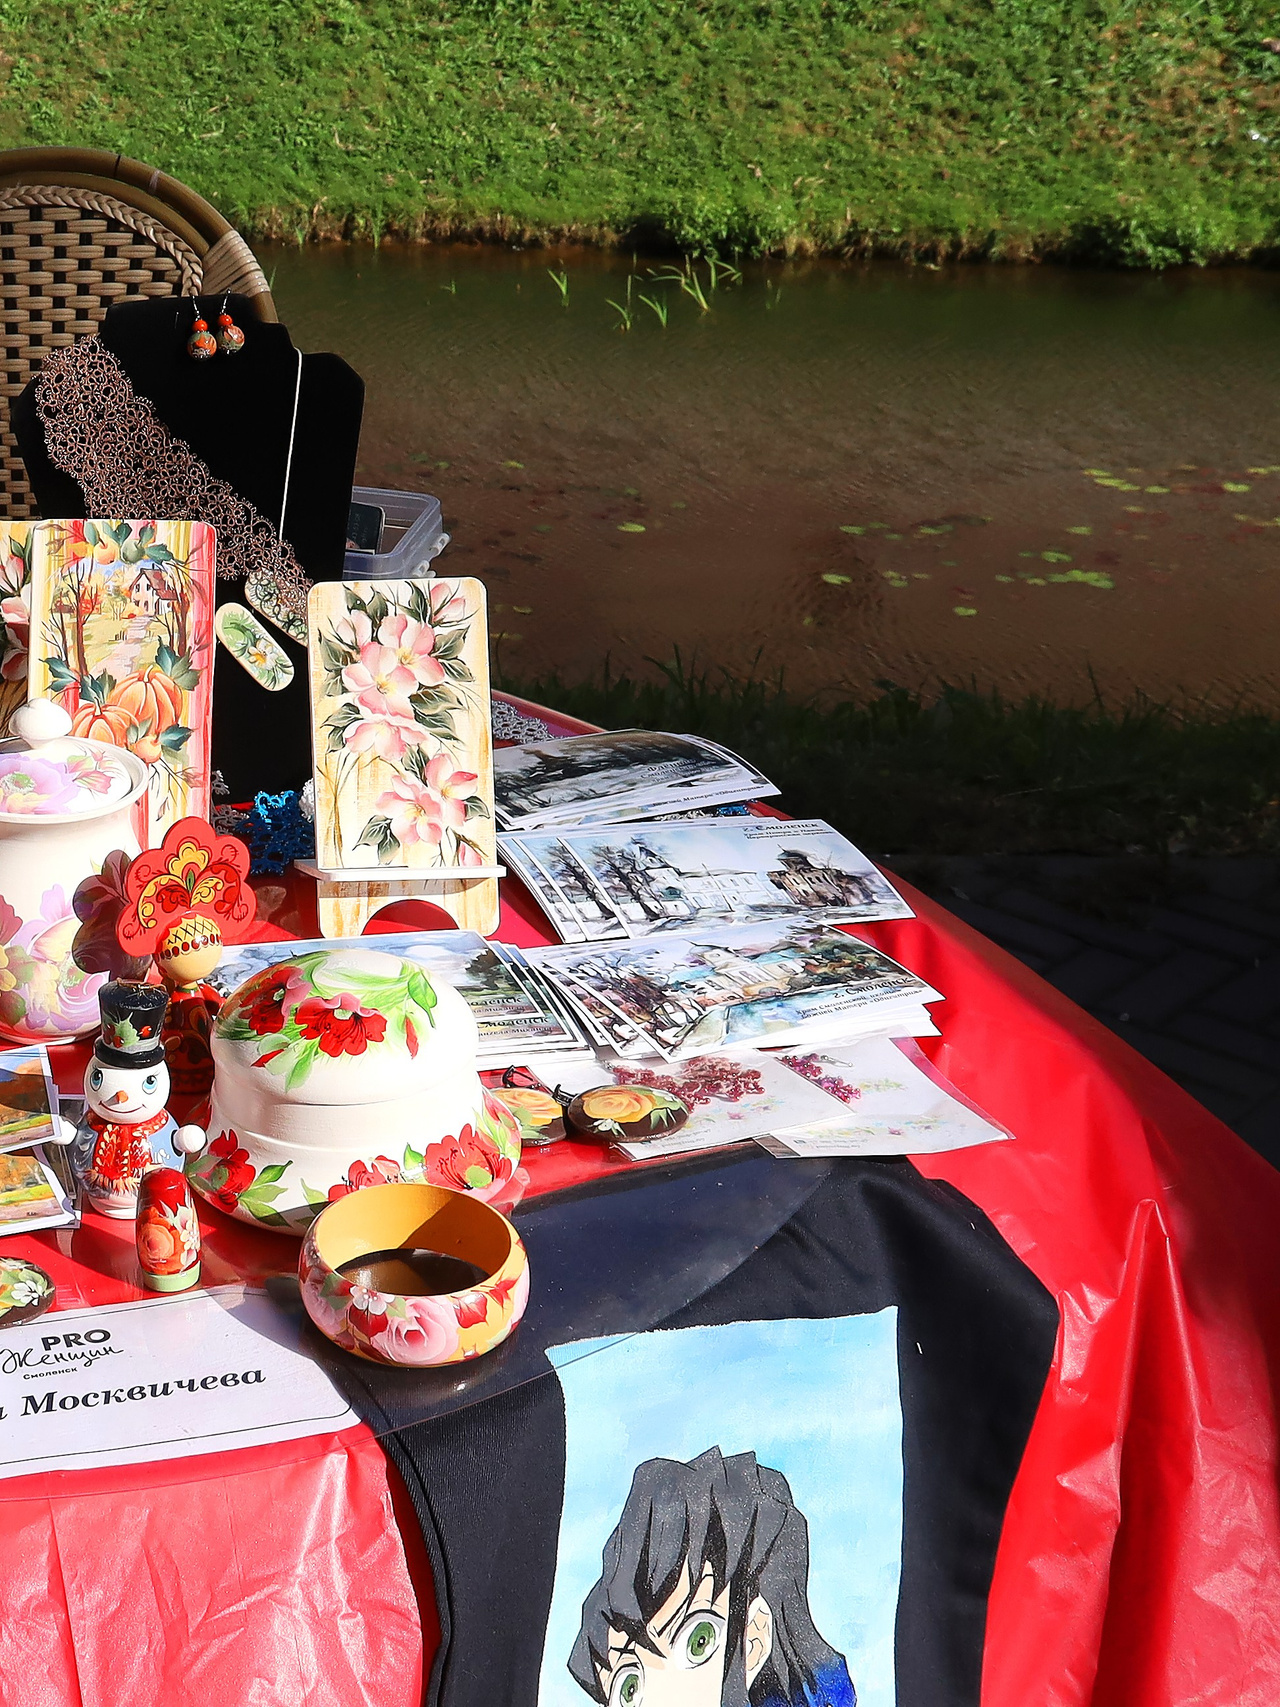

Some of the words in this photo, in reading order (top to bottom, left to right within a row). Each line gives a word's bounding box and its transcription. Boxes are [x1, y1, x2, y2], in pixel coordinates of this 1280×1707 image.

[755, 823, 820, 832] Смоленск
[845, 978, 911, 996] Смоленск
[467, 996, 523, 1006] оленск
[41, 1328, 112, 1352] PRO
[22, 1367, 79, 1381] Смоленск
[19, 1368, 267, 1417] Москвичева
